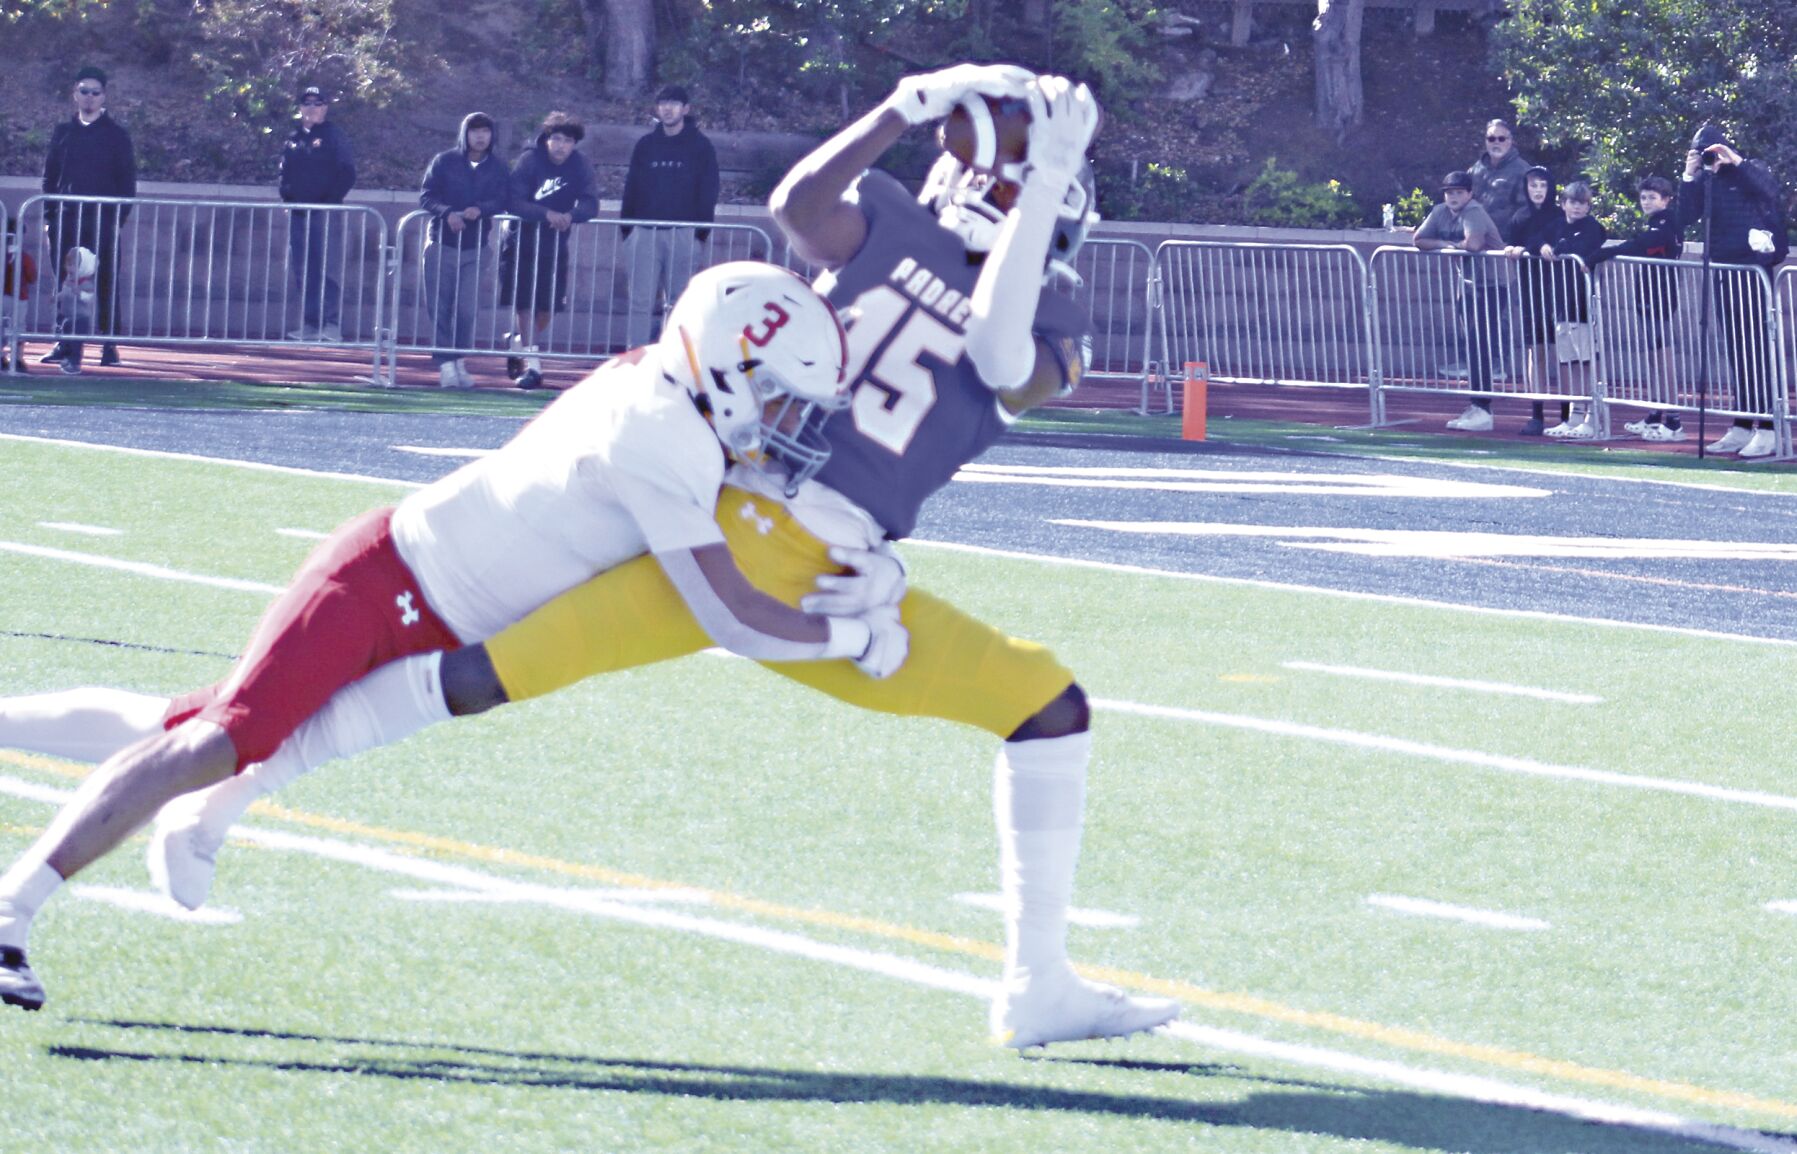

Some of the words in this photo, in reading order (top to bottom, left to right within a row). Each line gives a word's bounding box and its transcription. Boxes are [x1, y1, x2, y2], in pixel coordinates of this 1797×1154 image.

[743, 302, 790, 348] 3
[889, 257, 972, 329] PADRE
[844, 284, 968, 457] 15
